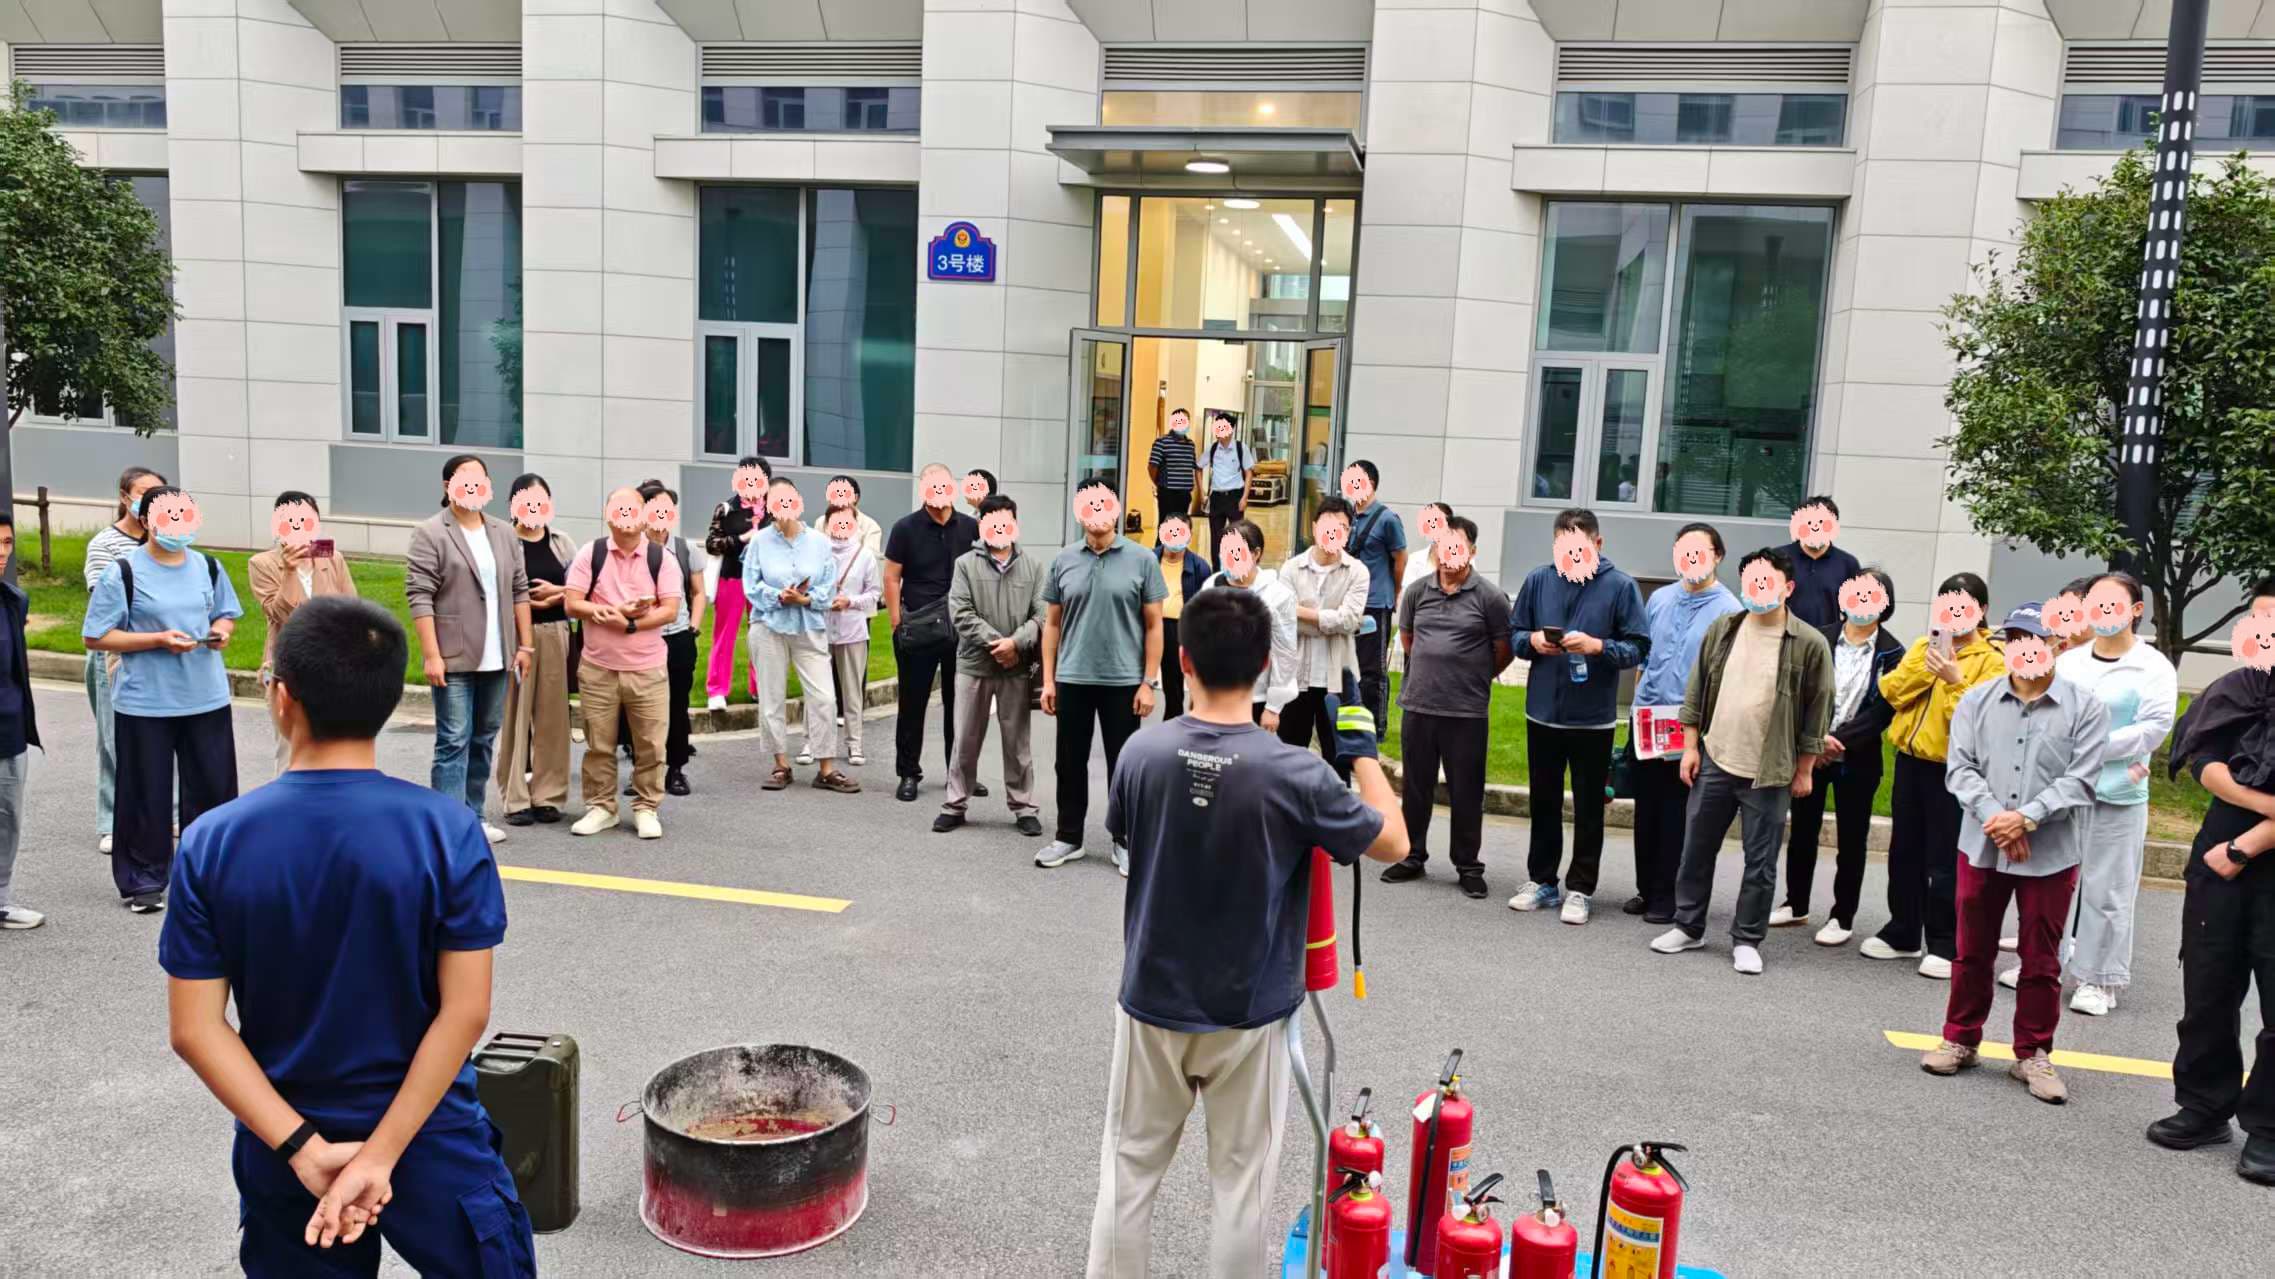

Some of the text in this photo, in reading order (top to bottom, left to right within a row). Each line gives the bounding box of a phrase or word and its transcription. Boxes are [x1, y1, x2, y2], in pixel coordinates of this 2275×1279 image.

[937, 254, 984, 273] 3号楼
[1178, 748, 1233, 765] DANGEROUS
[1187, 758, 1222, 772] PEOPLE
